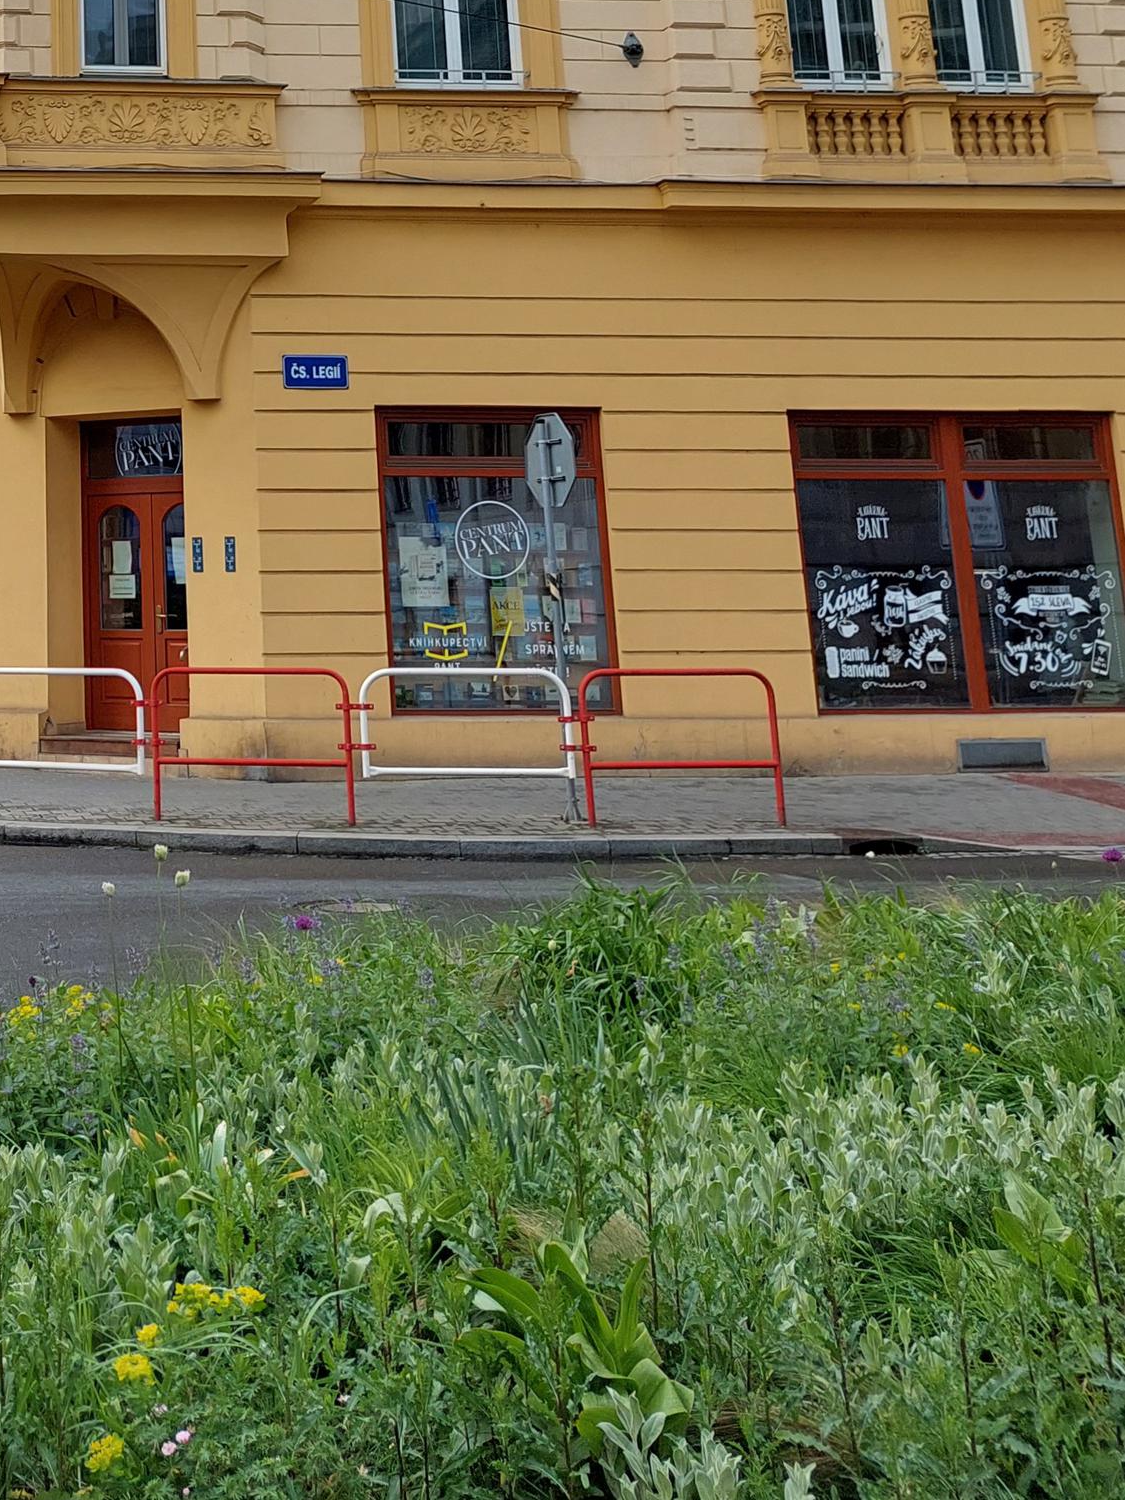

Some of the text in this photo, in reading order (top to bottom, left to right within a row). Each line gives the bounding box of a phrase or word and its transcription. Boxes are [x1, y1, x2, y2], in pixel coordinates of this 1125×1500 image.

[290, 362, 341, 379] ČS. LEGIÍ
[119, 430, 176, 452] CENTRUM
[119, 440, 175, 471] PANT
[459, 520, 523, 541] CENTRUM
[856, 517, 890, 541] PANT
[1025, 517, 1059, 541] PANT
[460, 530, 525, 560] PANT
[492, 601, 521, 610] AKCE
[817, 583, 869, 619] Káva
[524, 621, 551, 633] JSTE
[408, 635, 487, 648] KNIHKUPECTVÍ
[839, 646, 870, 664] panini
[1015, 652, 1059, 674] 7.30
[841, 662, 890, 678] sandwich
